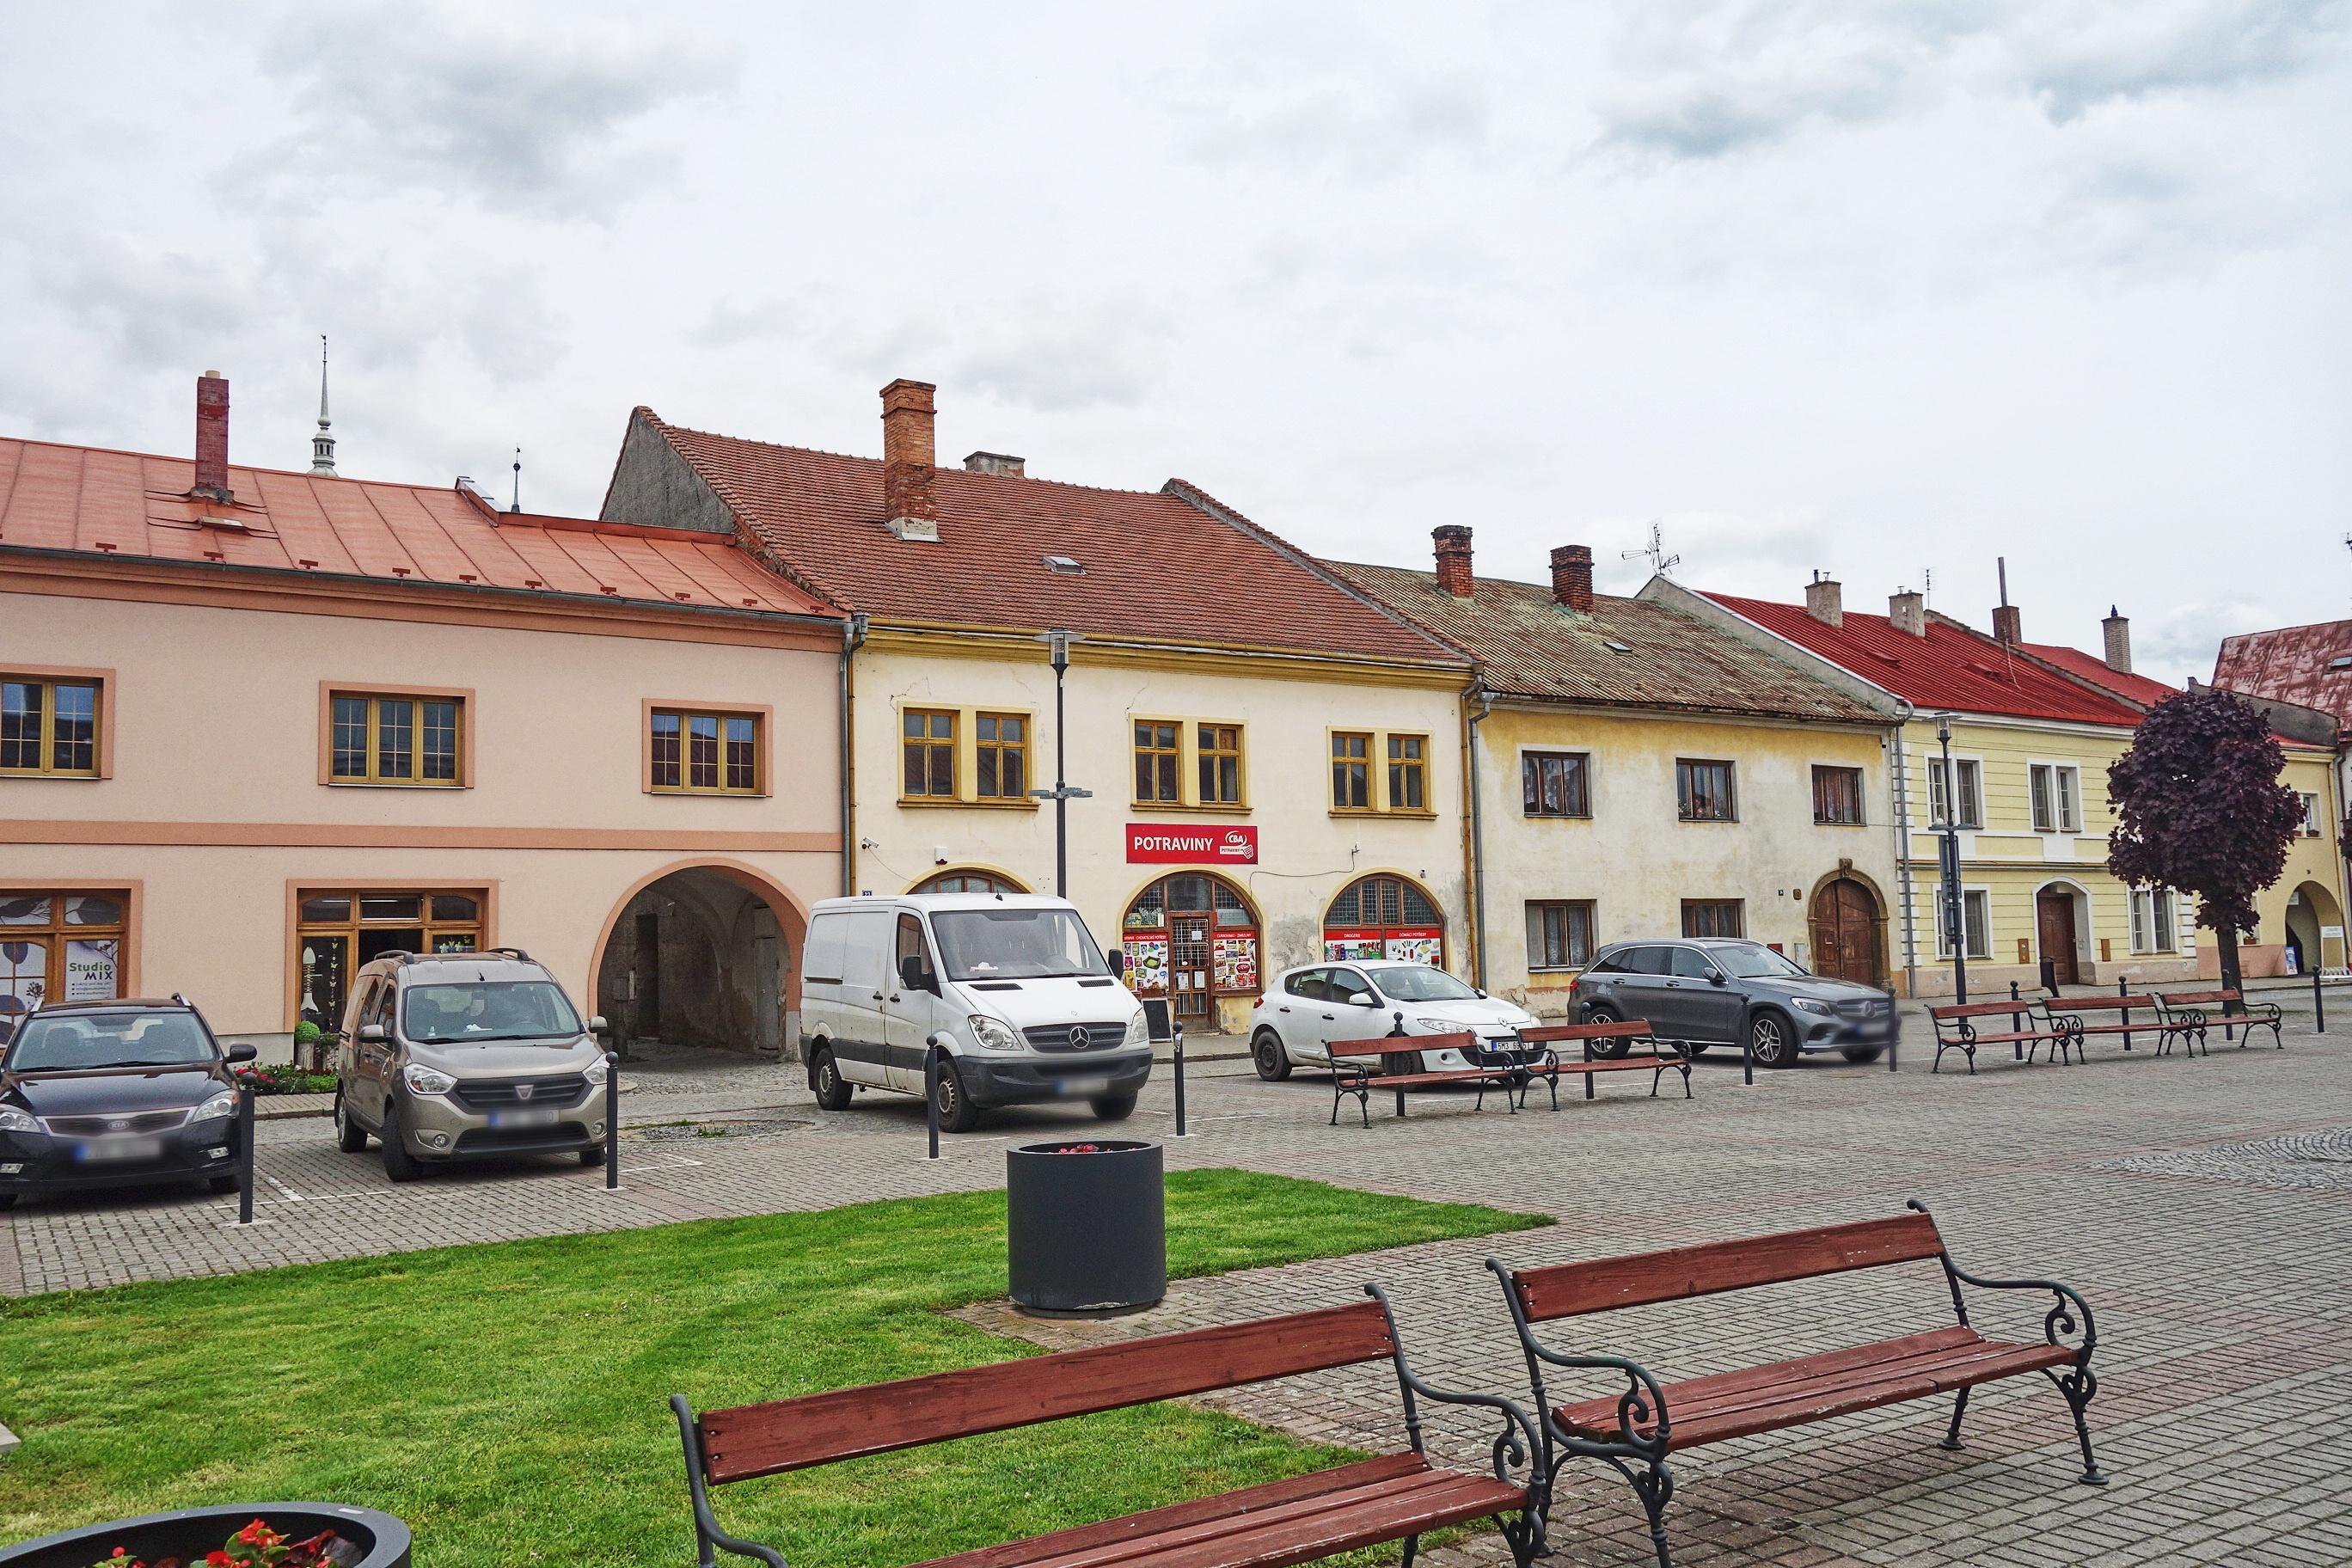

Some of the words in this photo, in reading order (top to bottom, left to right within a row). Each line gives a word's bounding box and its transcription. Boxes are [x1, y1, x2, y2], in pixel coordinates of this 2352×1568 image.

[1134, 836, 1213, 851] POTRAVINY
[1228, 835, 1244, 843] CBA
[70, 962, 111, 971] Studio
[84, 971, 113, 980] MIX
